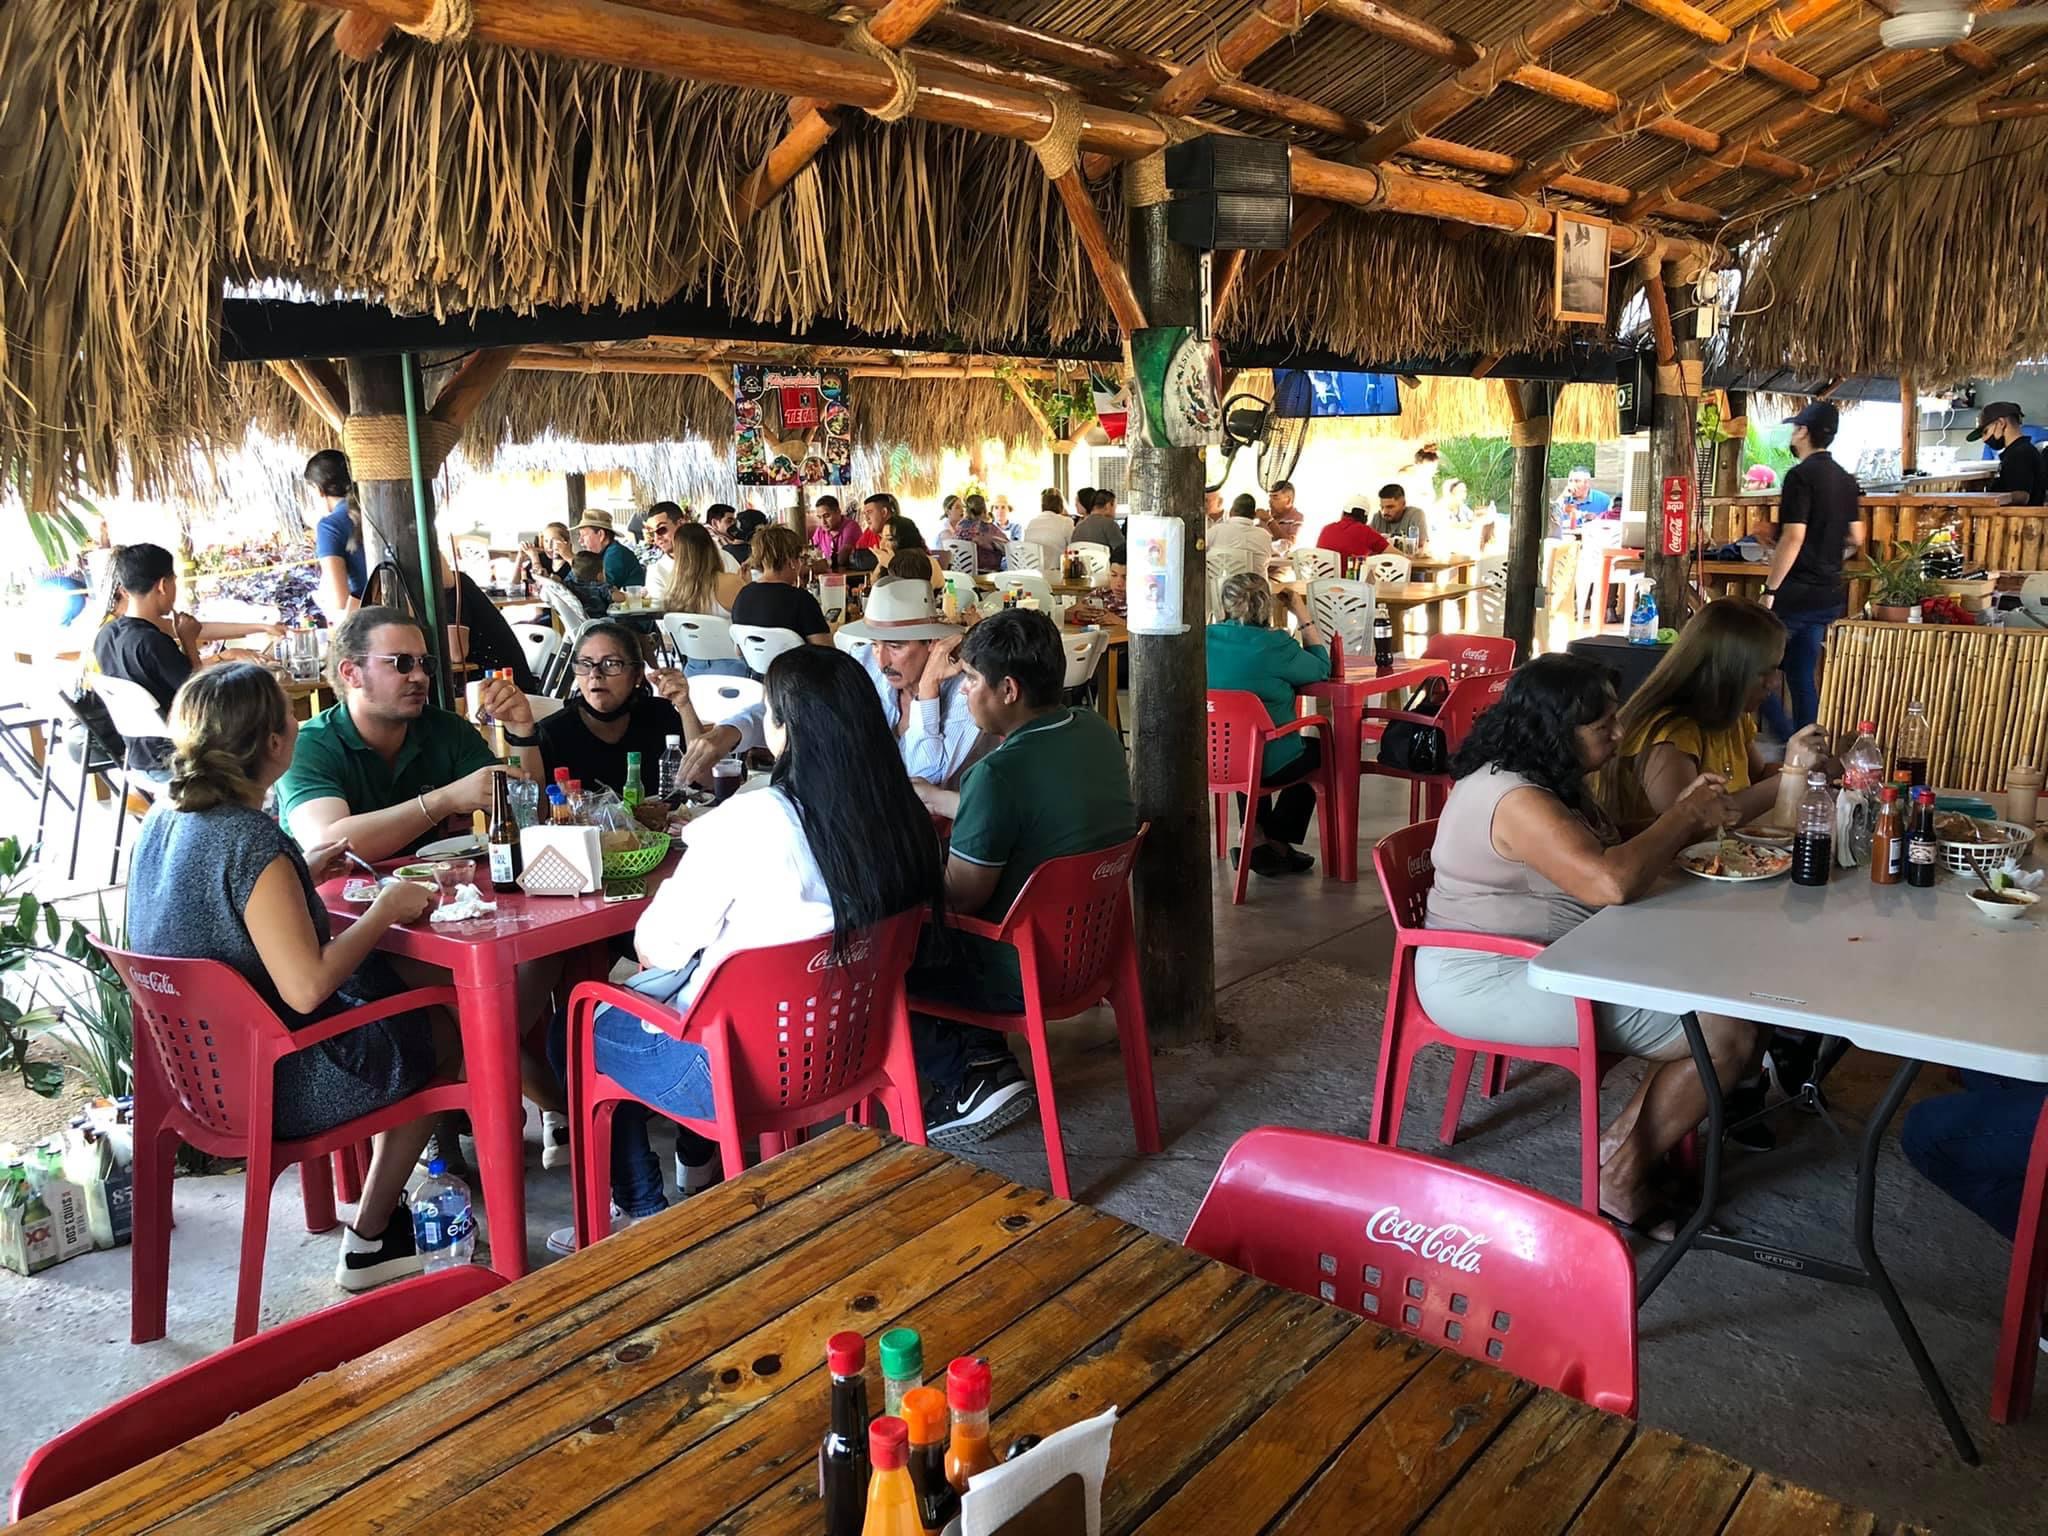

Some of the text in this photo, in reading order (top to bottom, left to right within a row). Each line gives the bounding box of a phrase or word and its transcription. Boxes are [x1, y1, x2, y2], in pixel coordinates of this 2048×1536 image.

[1669, 516, 1683, 553] Coca-Cola
[1462, 648, 1490, 661] Coca-Cola
[129, 966, 176, 995] Coca-Cola
[62, 1196, 75, 1225] EQUIS
[65, 1224, 77, 1245] DOS
[1366, 1205, 1492, 1273] Coca-Cola
[1759, 1252, 1798, 1267] LIFETIME
